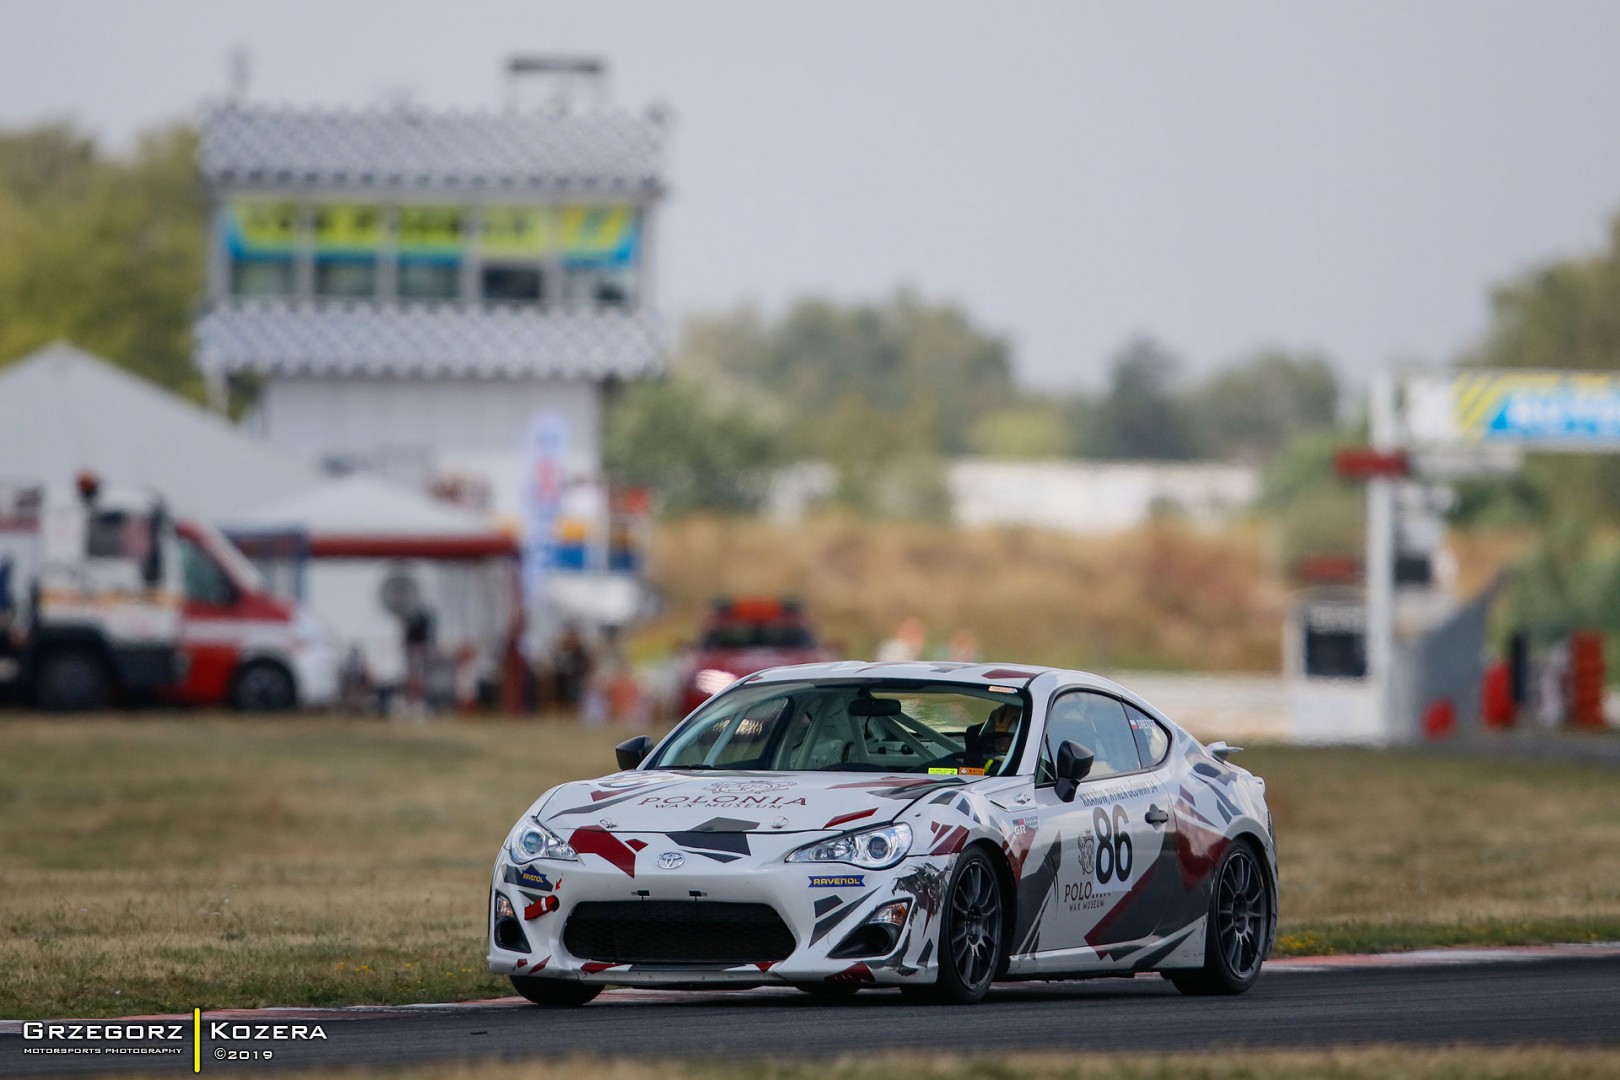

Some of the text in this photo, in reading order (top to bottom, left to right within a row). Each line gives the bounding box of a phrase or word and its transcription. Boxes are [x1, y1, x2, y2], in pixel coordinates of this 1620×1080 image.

[637, 795, 807, 806] POLONIA
[1014, 824, 1026, 836] GR
[1093, 804, 1133, 884] 86
[1069, 900, 1105, 912] WAX MUSEUM
